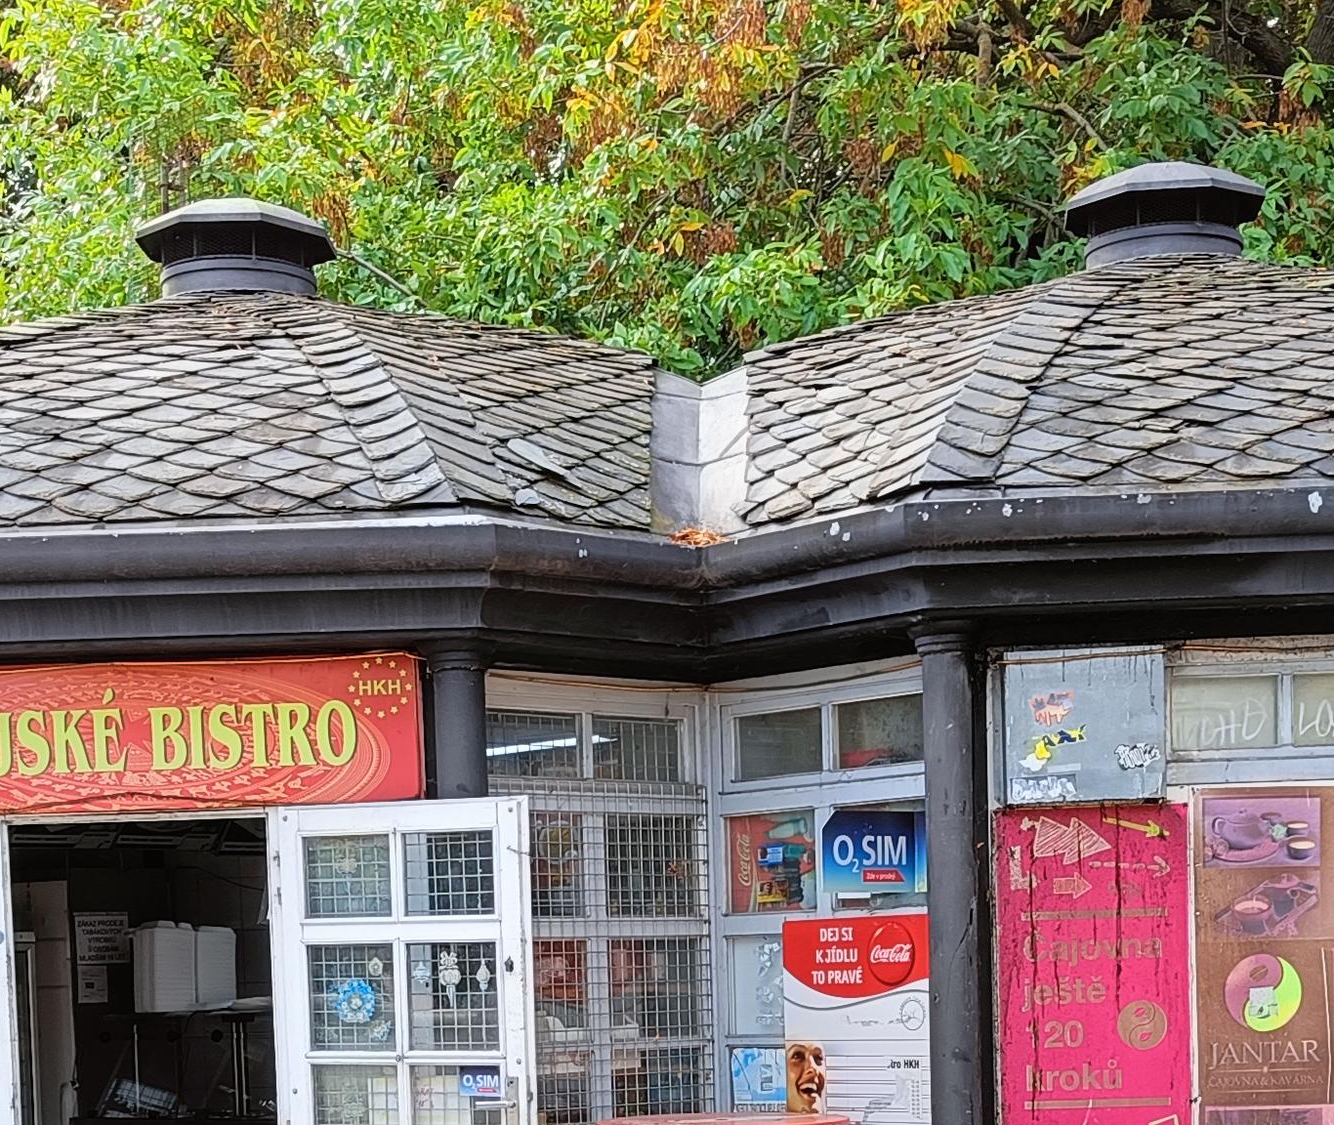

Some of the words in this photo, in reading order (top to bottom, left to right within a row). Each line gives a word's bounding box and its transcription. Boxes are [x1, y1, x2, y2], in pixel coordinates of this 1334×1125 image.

[358, 678, 401, 696] HKH
[153, 700, 358, 772] BISTRO
[862, 835, 907, 866] SIM
[820, 928, 839, 942] DEJ
[841, 927, 853, 941] SI
[1023, 928, 1163, 967] Čajovna
[816, 949, 823, 963] K
[825, 945, 858, 963] JÍDLU
[811, 970, 825, 984] TO
[828, 966, 863, 984] PRAVÉ
[1022, 976, 1107, 1012] ještě
[1208, 1040, 1321, 1070] JANTAR
[476, 1074, 499, 1088] SIM
[1026, 1059, 1123, 1092] kroků
